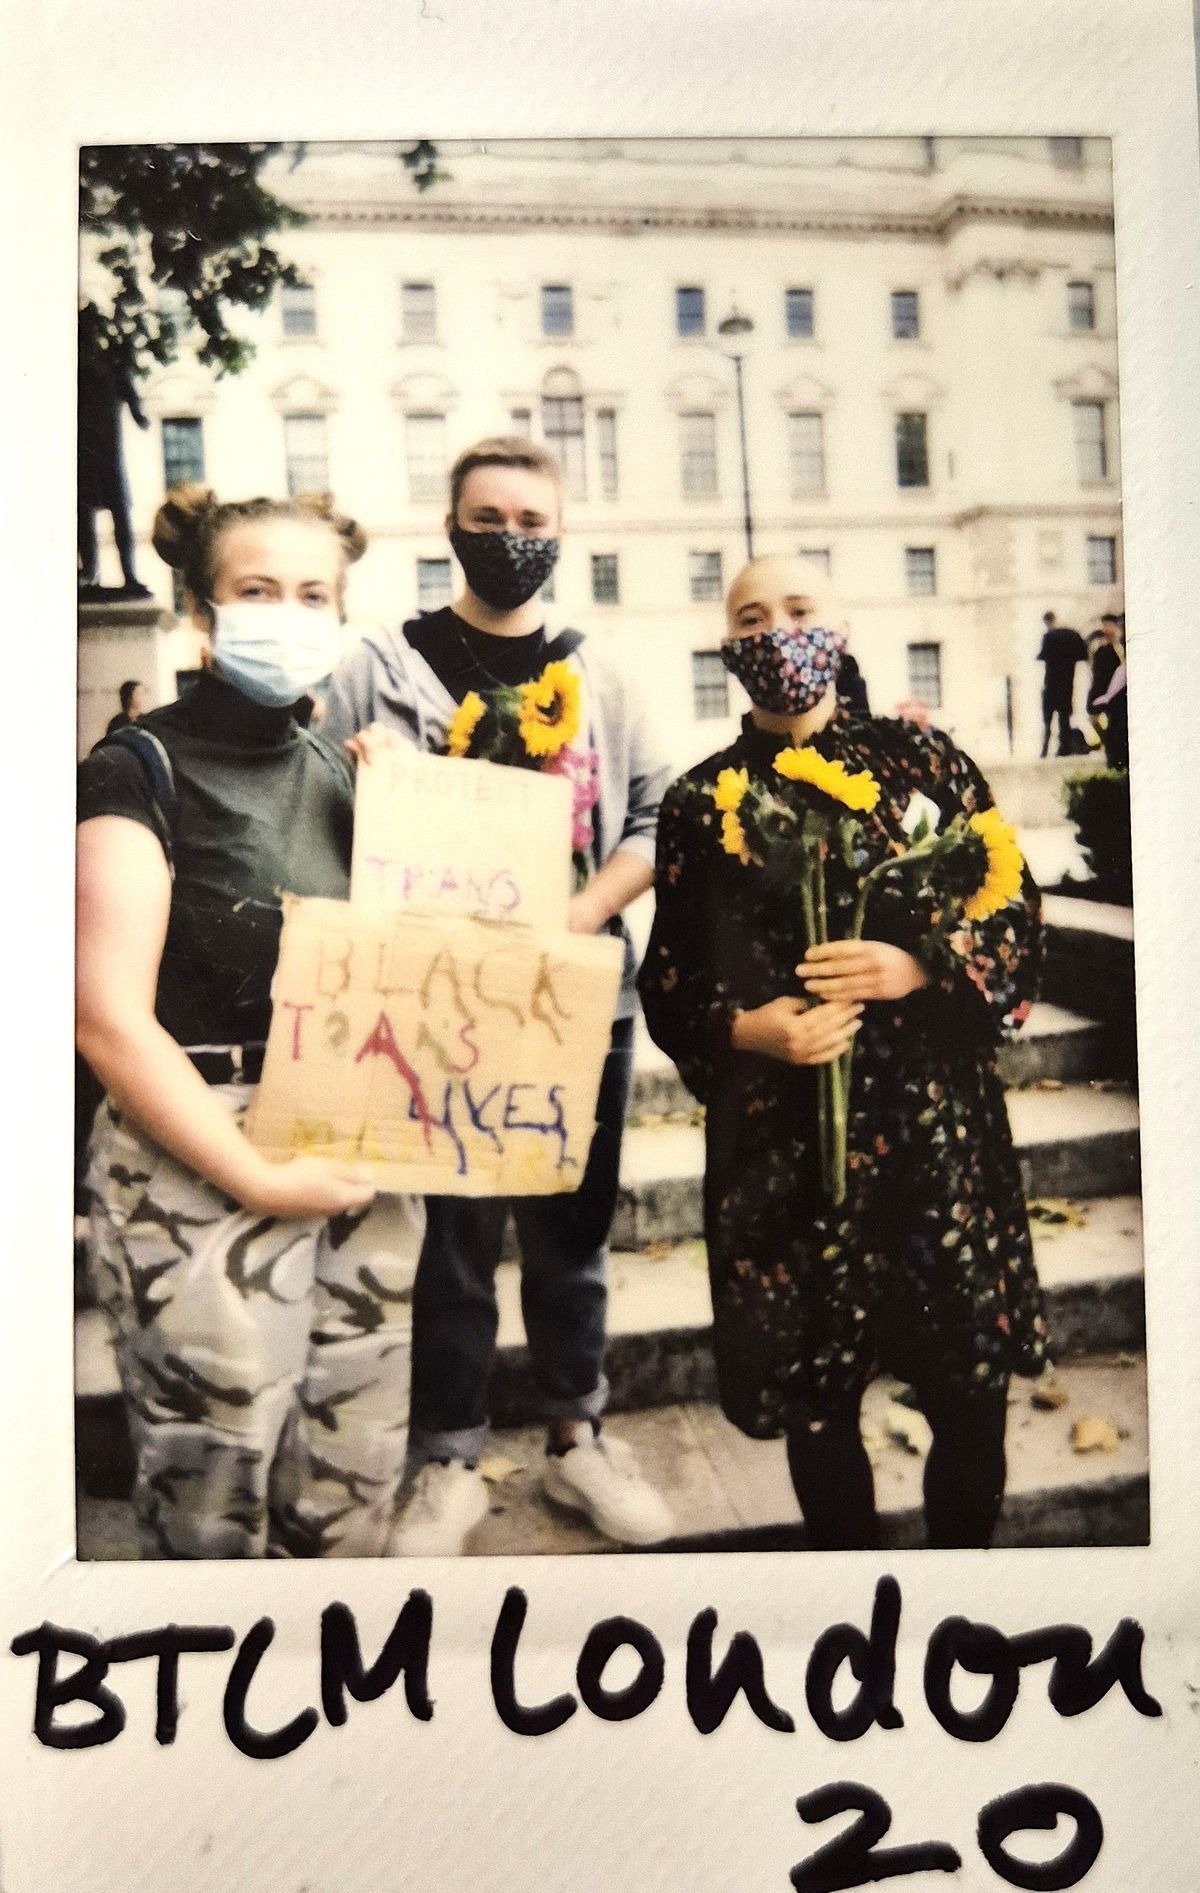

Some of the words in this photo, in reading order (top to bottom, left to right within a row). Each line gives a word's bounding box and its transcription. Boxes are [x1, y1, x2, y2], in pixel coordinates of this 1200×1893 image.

[366, 856, 521, 913] TRANS
[316, 939, 570, 1044] BLACK
[408, 1077, 577, 1175] LIVES
[491, 1577, 1162, 1742] London
[790, 1783, 1103, 1893] 20
